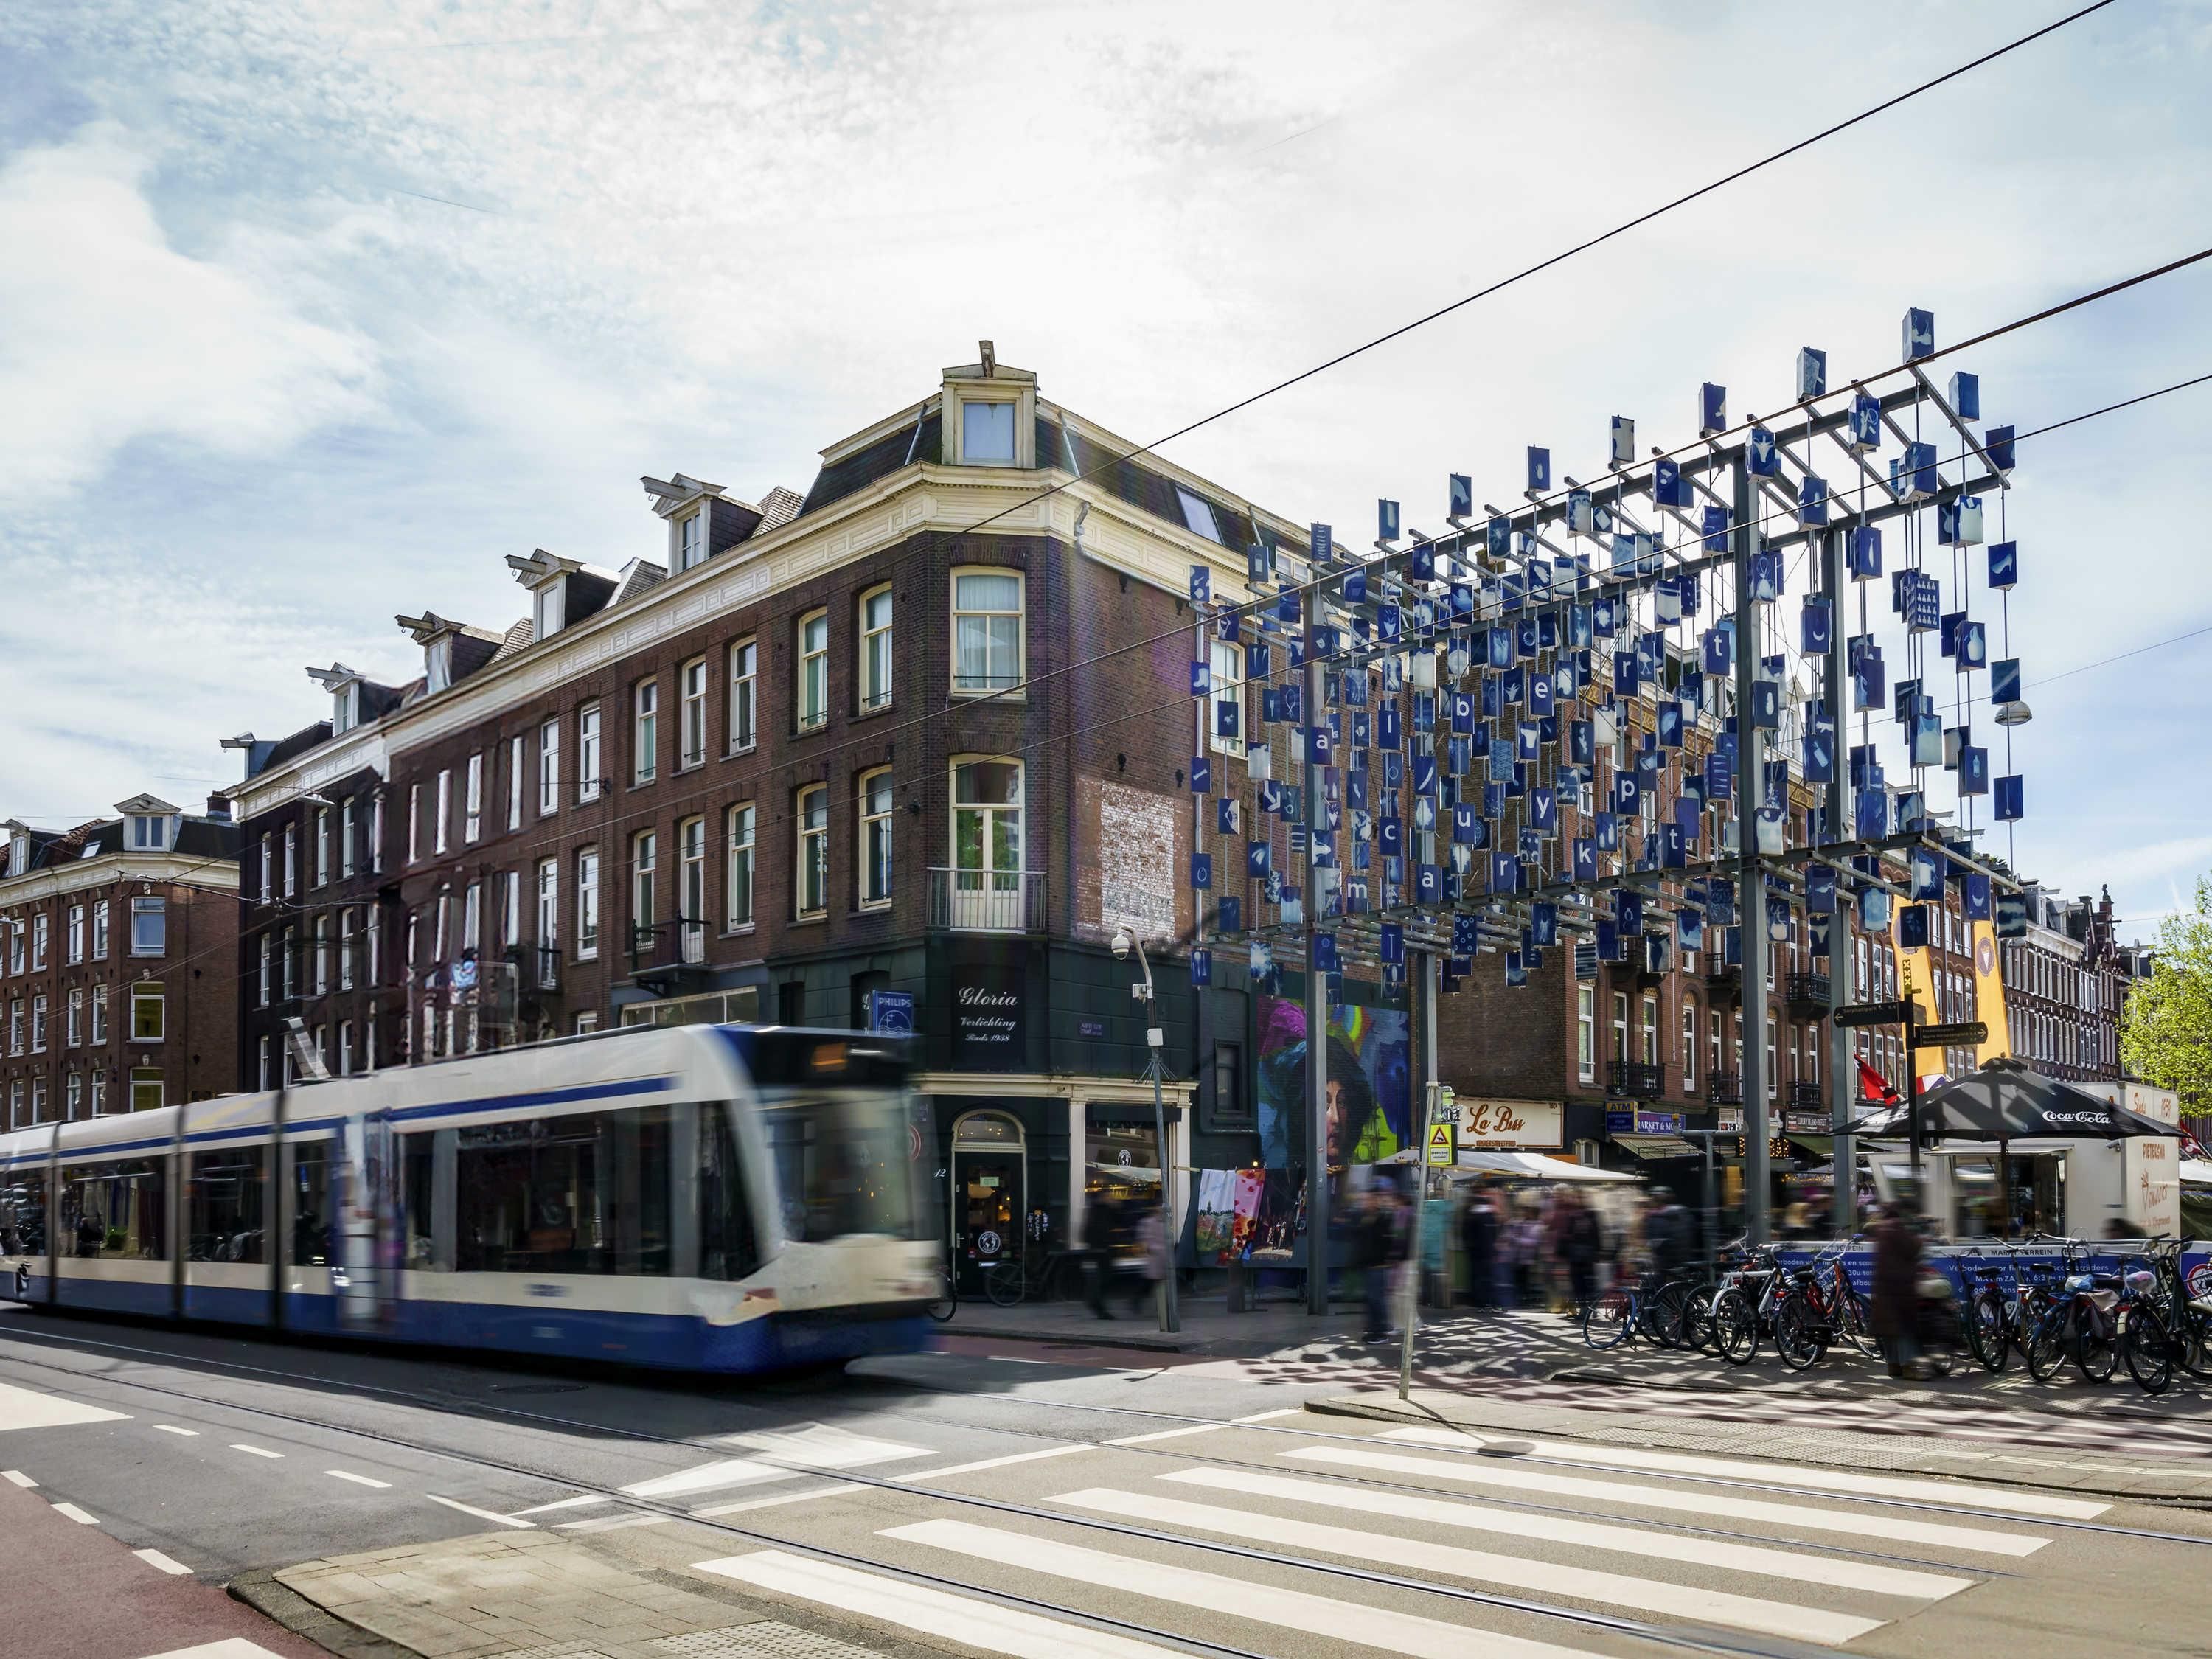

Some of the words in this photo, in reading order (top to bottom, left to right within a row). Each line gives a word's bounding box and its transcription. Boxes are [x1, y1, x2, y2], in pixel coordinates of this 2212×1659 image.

[1316, 735, 1328, 750] a
[1456, 697, 1470, 717] b
[1534, 681, 1548, 698] e
[1622, 661, 1631, 677] r
[1714, 635, 1722, 656] t
[1385, 824, 1397, 841] c
[1458, 811, 1470, 827] u
[1536, 796, 1550, 819] y
[1622, 779, 1635, 802] p
[1347, 883, 1368, 898] m
[1422, 872, 1434, 888] a
[1579, 842, 1592, 863] k
[1669, 828, 1678, 849] t
[879, 997, 912, 1008] PHILIPS
[959, 987, 1018, 1005] Gloria
[961, 1017, 1016, 1031] Verlichting
[1466, 1104, 1492, 1135] La
[2042, 1110, 2112, 1124] Coca-Cola
[1666, 1121, 1682, 1131] MOE
[933, 1168, 947, 1178] 12
